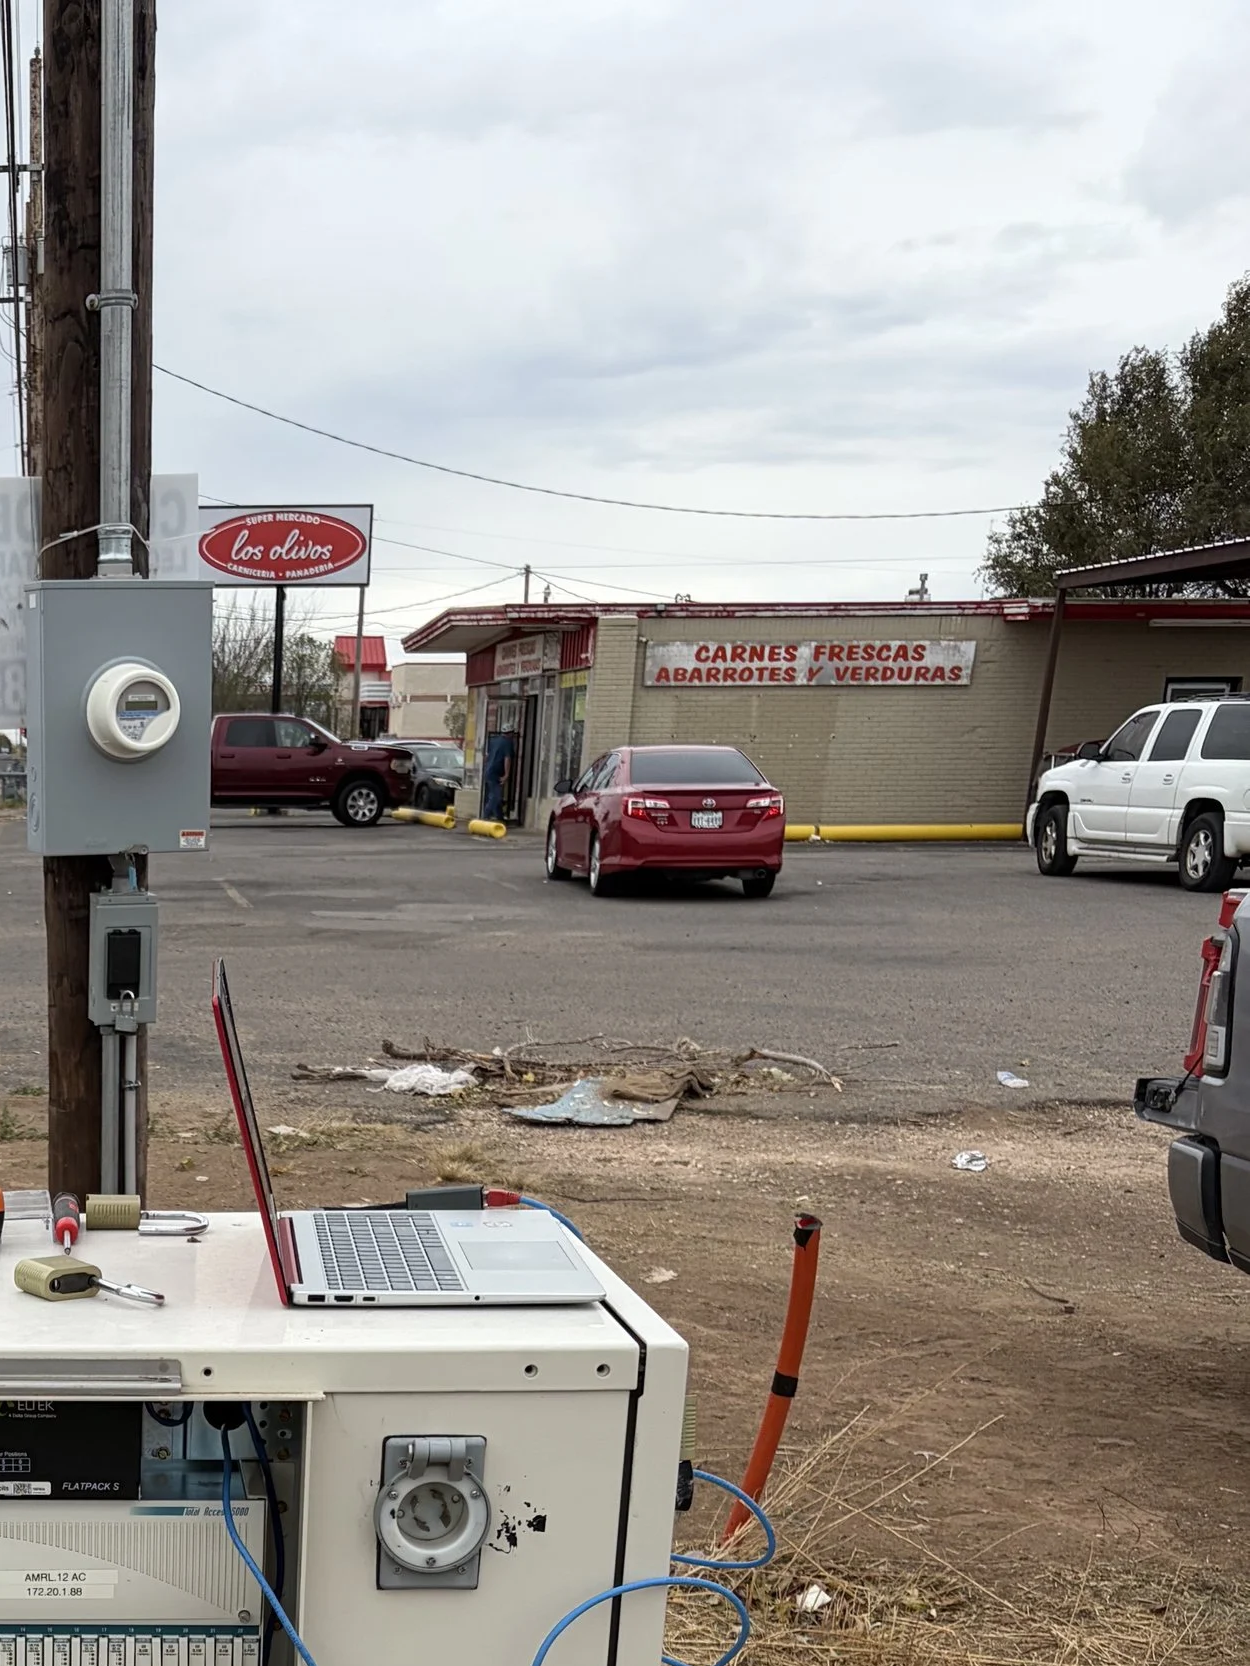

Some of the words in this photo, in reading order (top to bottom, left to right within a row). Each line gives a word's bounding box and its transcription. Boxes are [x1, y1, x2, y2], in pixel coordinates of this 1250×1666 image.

[245, 513, 274, 526] SUPER
[276, 513, 321, 525] MERCADO
[231, 529, 264, 561] los
[269, 529, 333, 560] olivos
[226, 562, 276, 579] CARNICERIA
[285, 562, 334, 579] PANADERIA
[695, 644, 799, 663] CARNES
[813, 644, 926, 662] FRESCAS
[655, 666, 796, 683] ABARROTES
[806, 667, 822, 683] Y
[834, 666, 962, 682] VERDURAS
[62, 1482, 110, 1490] FLATPACK
[112, 1482, 120, 1490] S
[24, 1572, 69, 1582] AMRL.12
[71, 1572, 87, 1582] AC
[27, 1587, 83, 1597] 172.20.1.88
